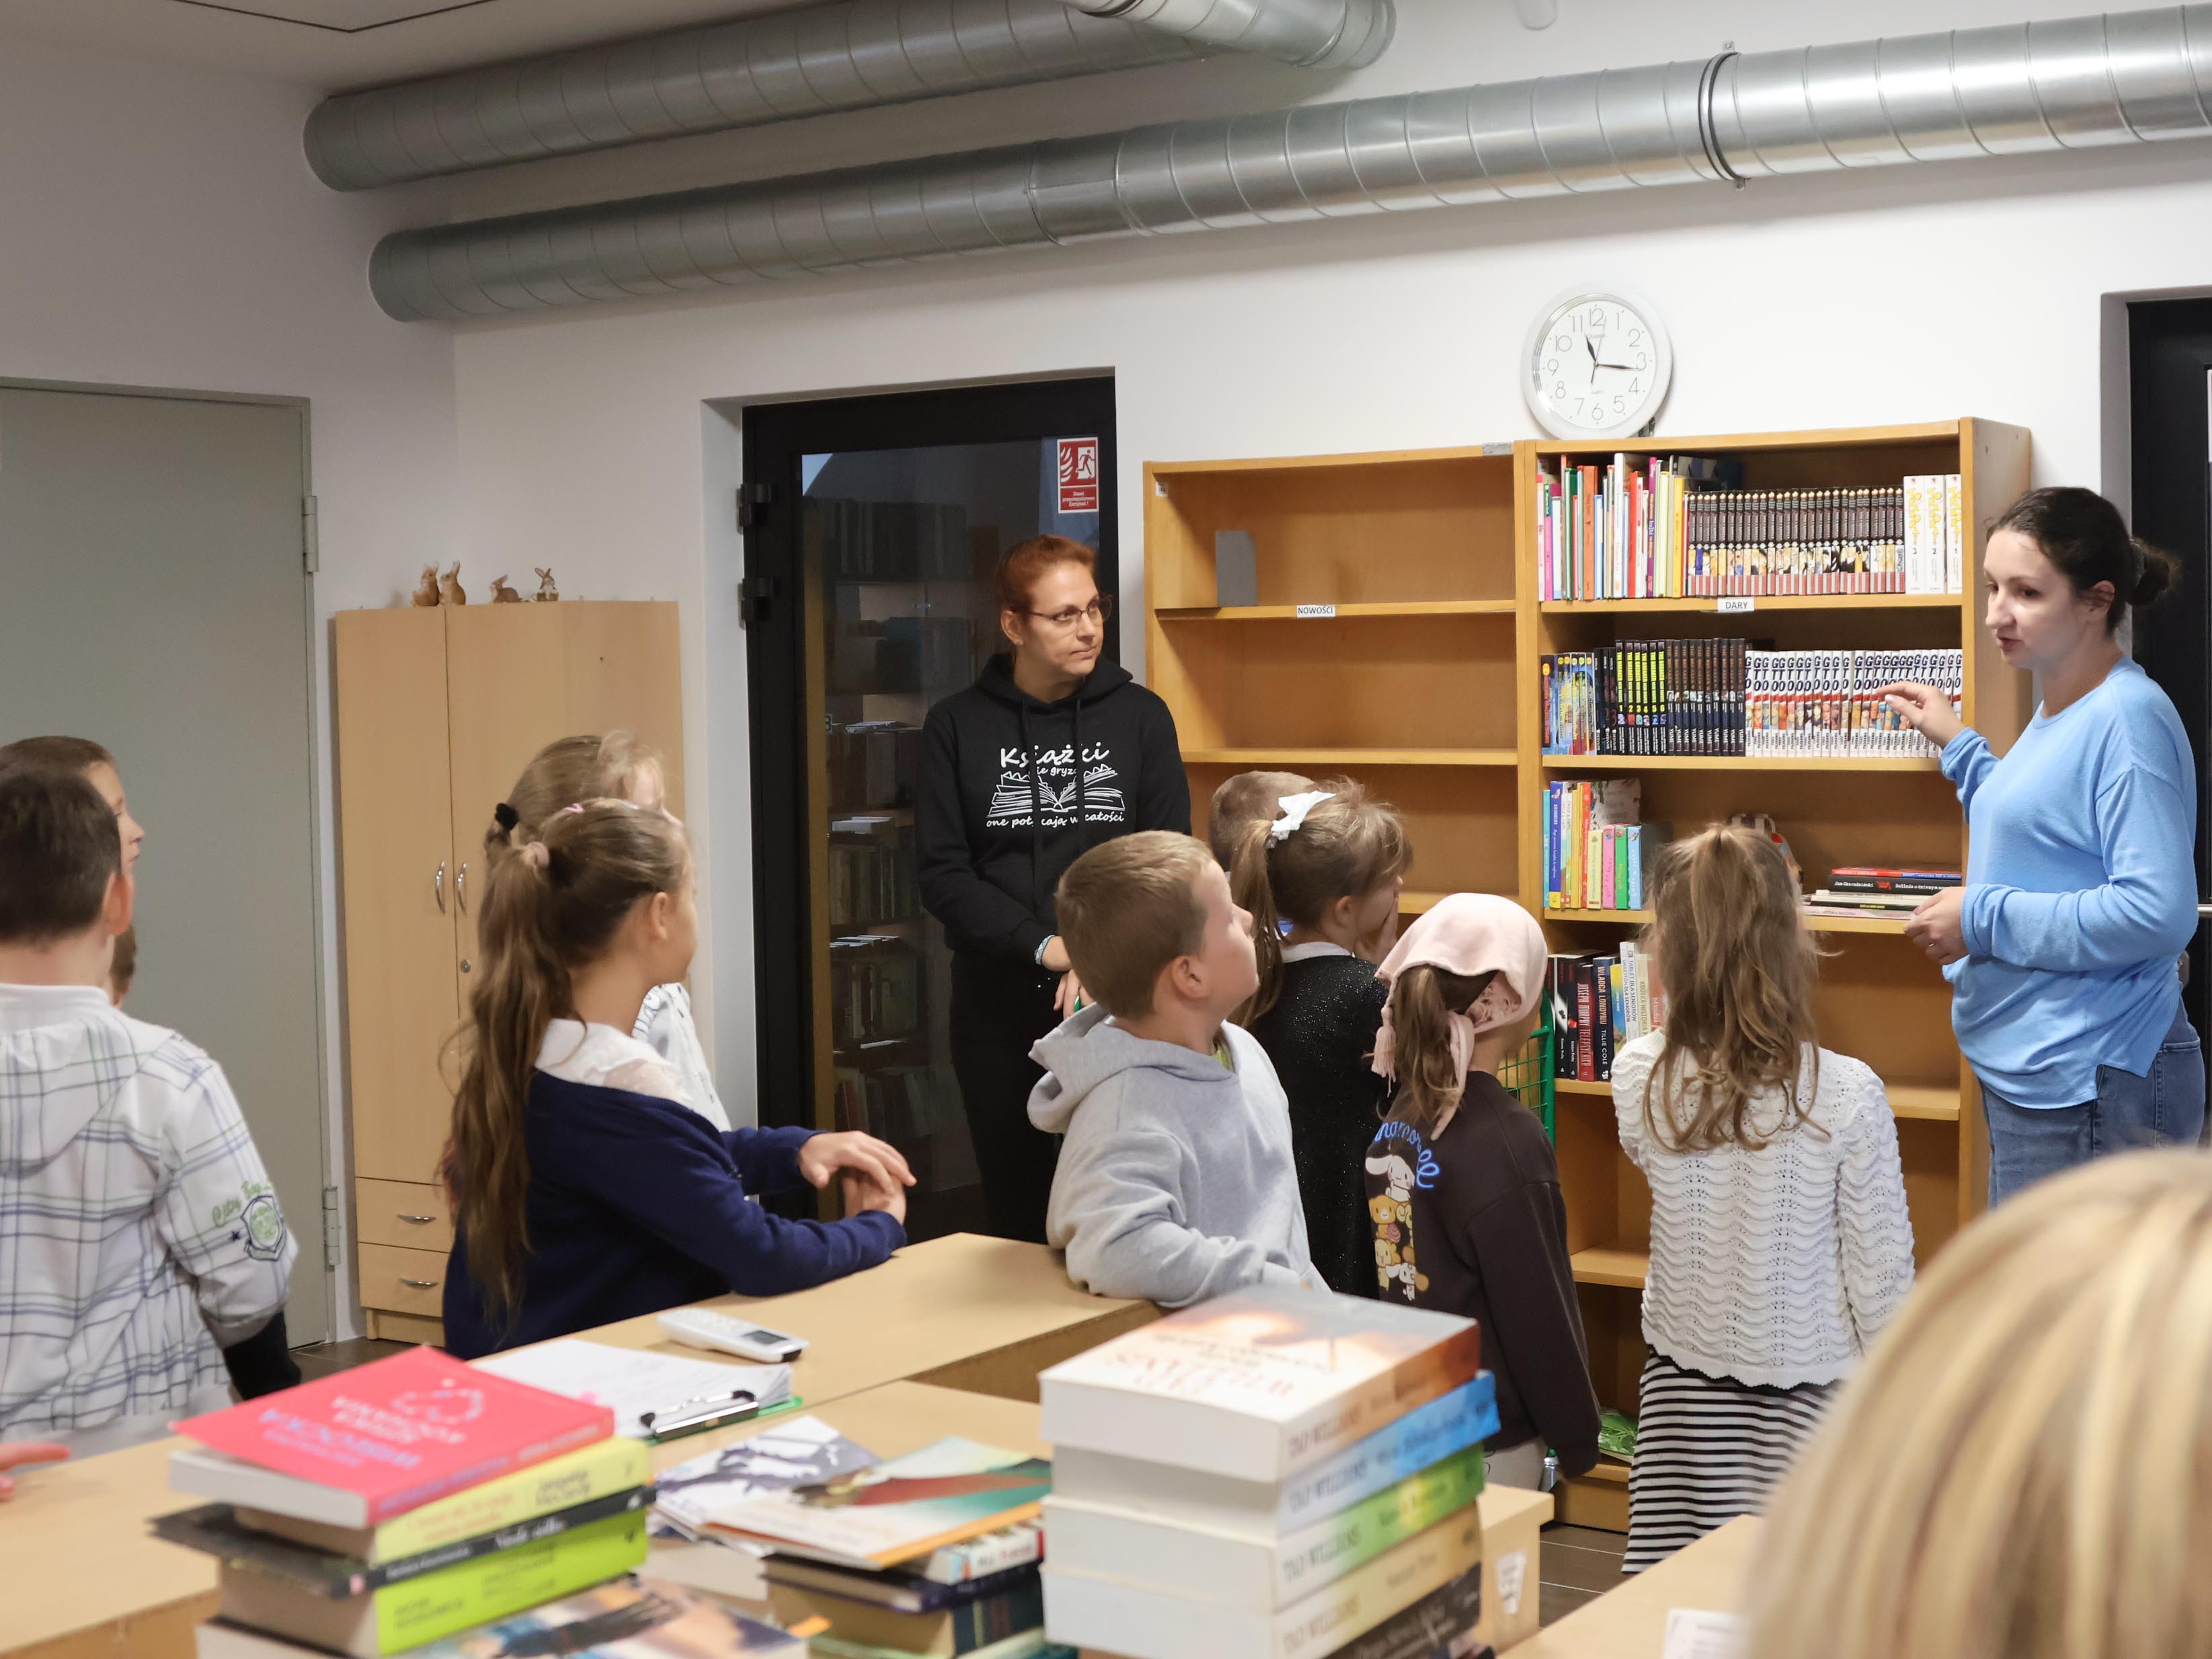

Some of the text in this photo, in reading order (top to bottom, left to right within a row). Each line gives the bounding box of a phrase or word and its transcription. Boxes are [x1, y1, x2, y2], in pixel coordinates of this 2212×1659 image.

[1572, 315, 1583, 332] 11
[1589, 308, 1604, 326] 12
[1555, 335, 1572, 352] 10
[1629, 329, 1640, 347] 2
[1547, 359, 1559, 376] 9
[1636, 352, 1647, 371] 3
[1555, 381, 1566, 399] 8
[1629, 378, 1640, 394] 4
[1574, 398, 1584, 415] 7
[1592, 403, 1603, 420] 6
[1614, 395, 1625, 413] 5
[1298, 605, 1333, 614] NOWOŚCI
[1854, 656, 1863, 690] GTO
[1864, 656, 1873, 690] GTO
[1872, 655, 1881, 689] GTO
[1905, 656, 1913, 681] GT
[1927, 655, 1937, 686] GTO
[1937, 656, 1945, 688] GTO
[1946, 655, 1954, 688] GTO
[986, 817, 1009, 827] one
[1085, 811, 1124, 822] całości
[1577, 983, 1589, 1002] JOSEPH
[1579, 1005, 1590, 1026] MURPHY
